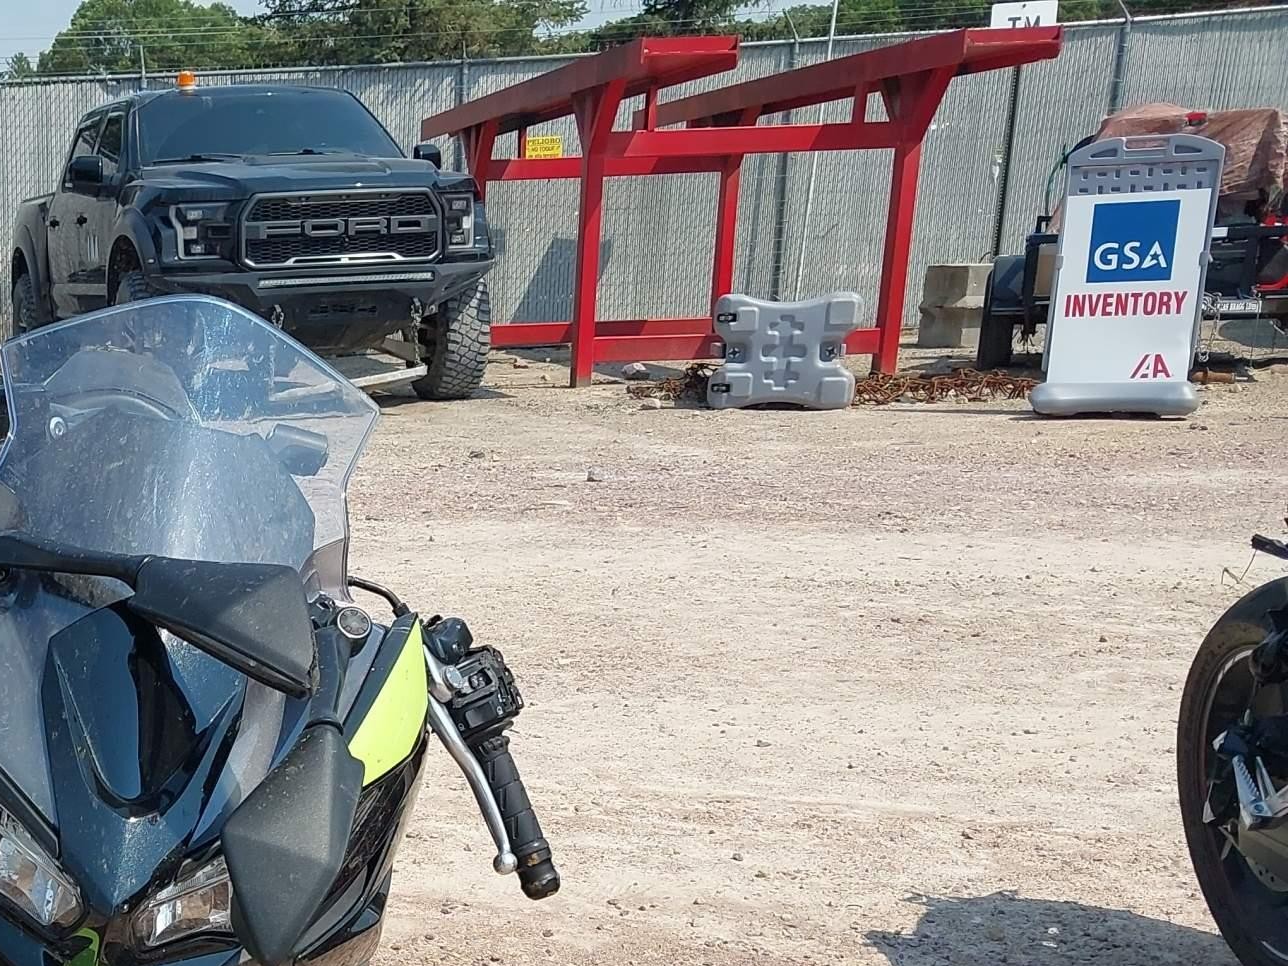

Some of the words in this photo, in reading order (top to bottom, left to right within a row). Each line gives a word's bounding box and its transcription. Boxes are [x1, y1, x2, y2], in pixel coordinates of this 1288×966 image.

[258, 216, 427, 240] FORD
[1094, 240, 1167, 271] GSA
[1064, 291, 1188, 317] INVENTORY
